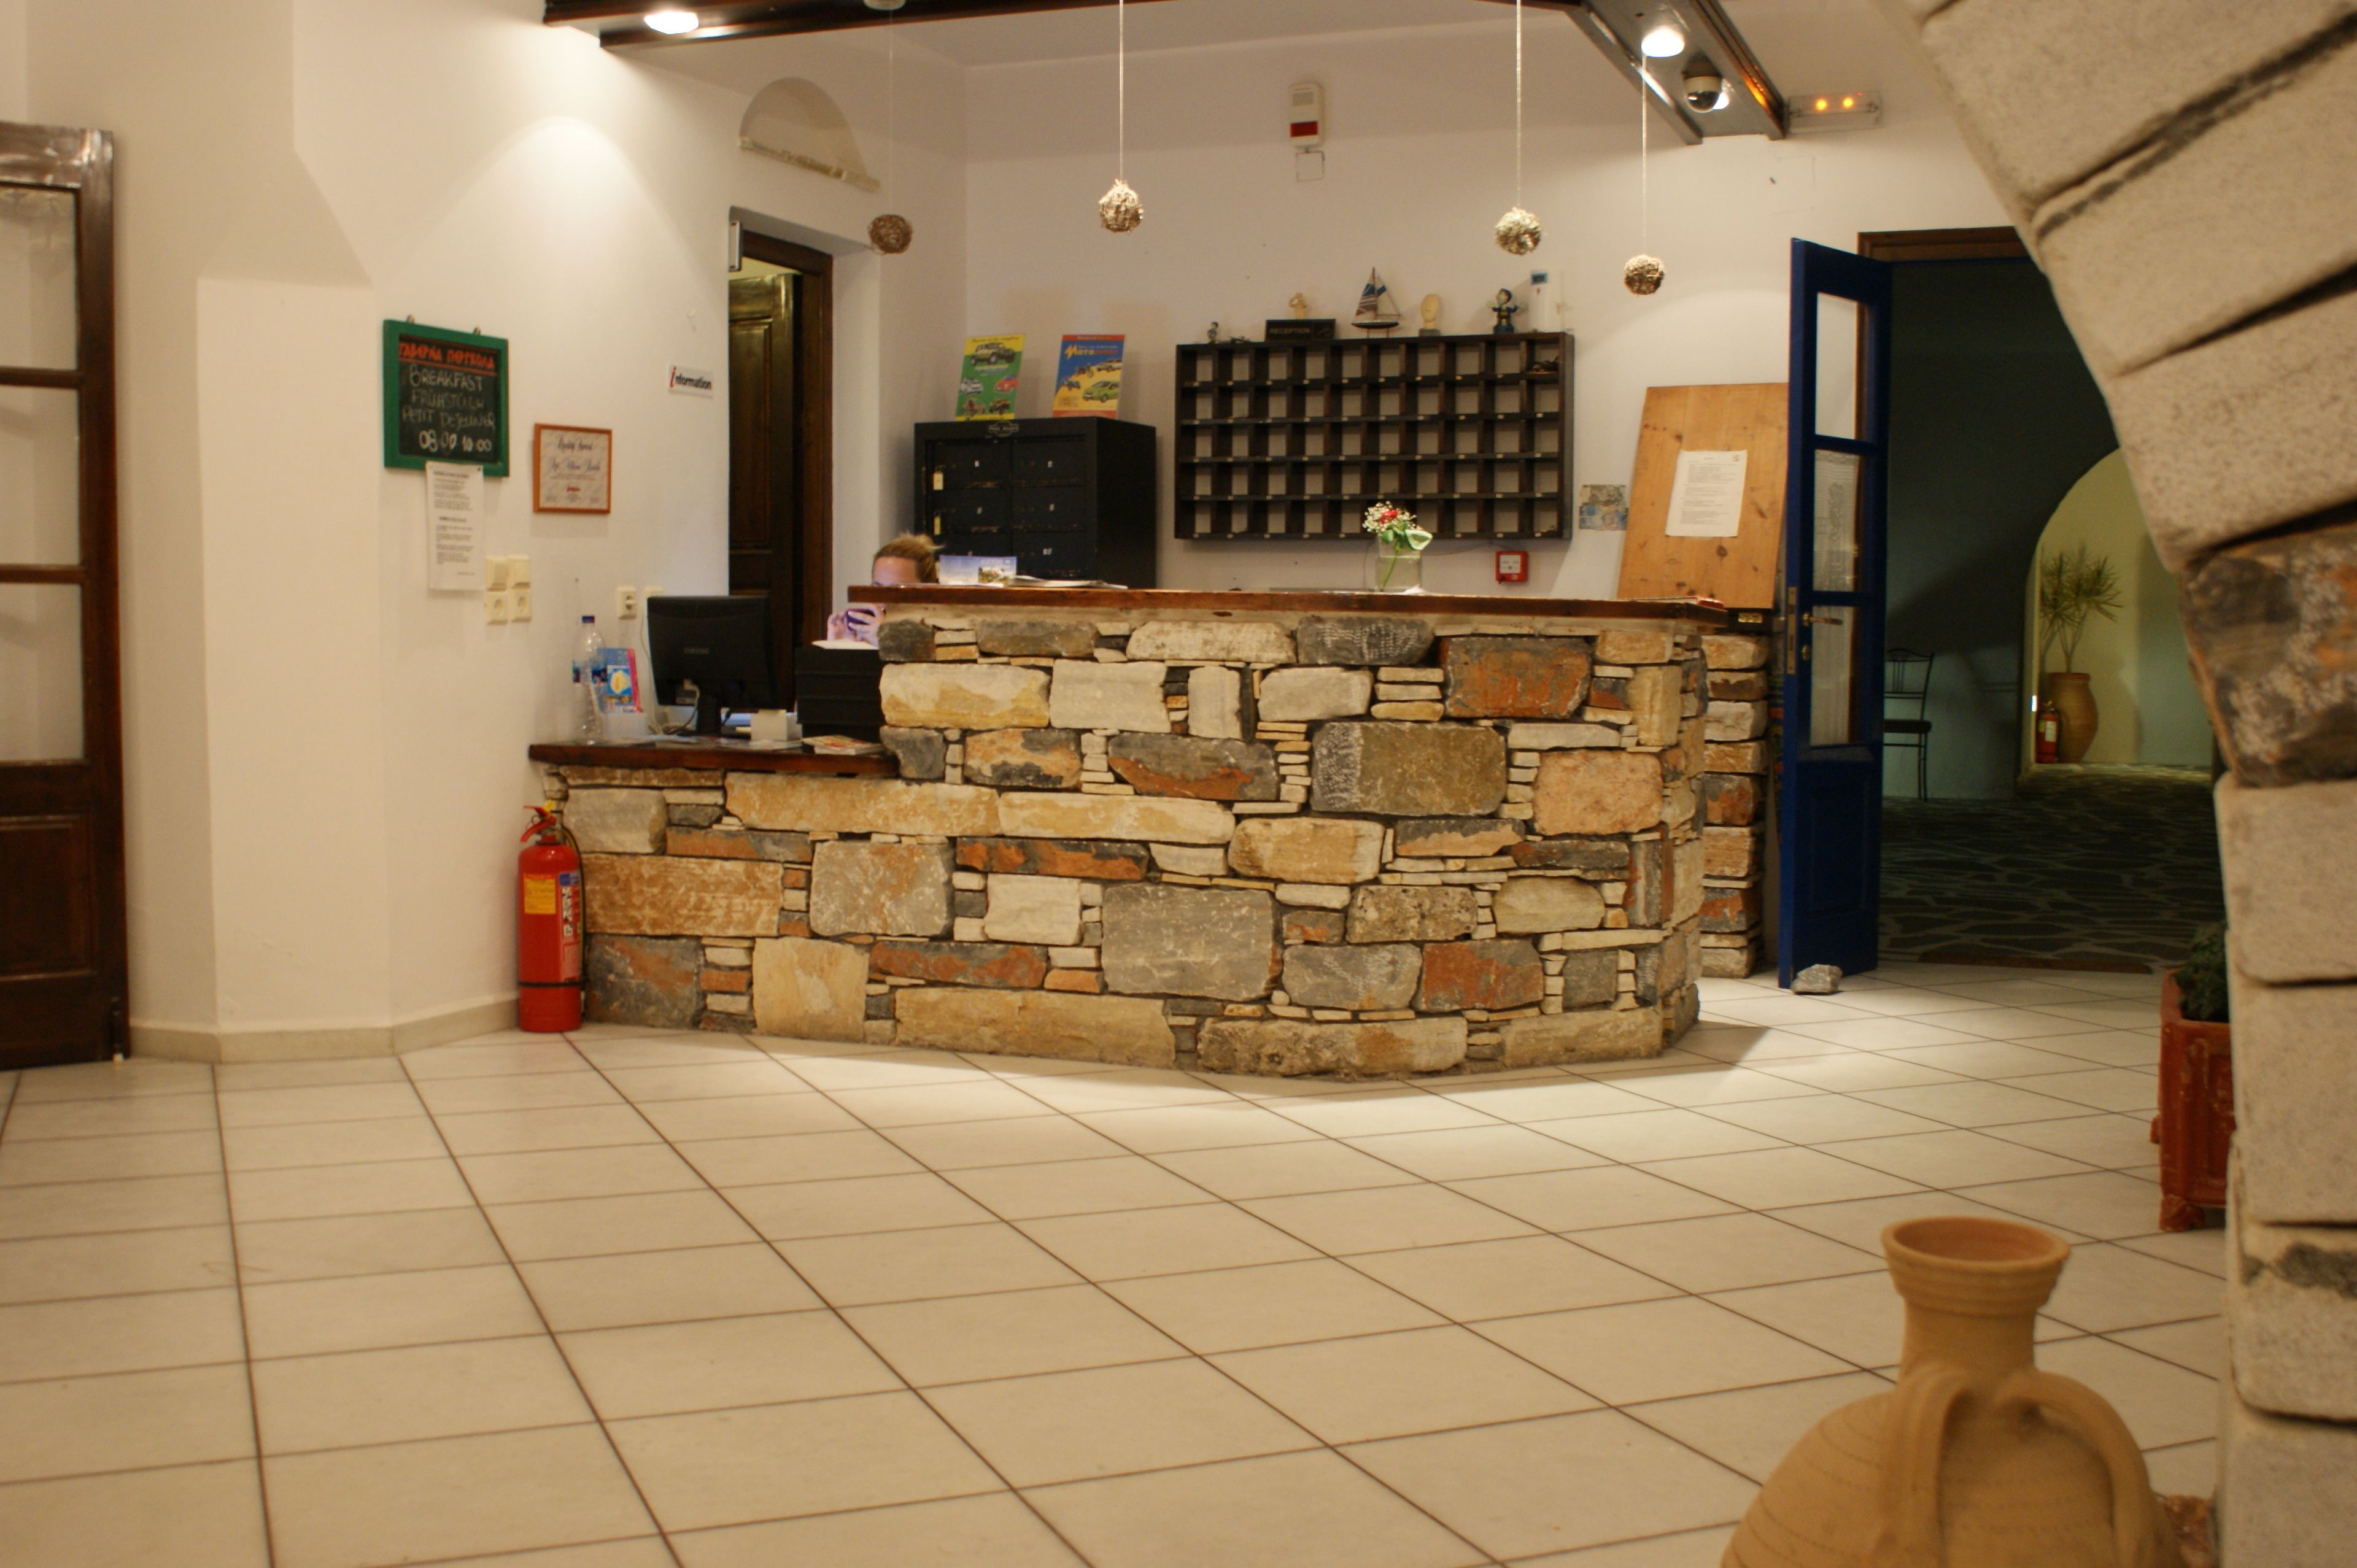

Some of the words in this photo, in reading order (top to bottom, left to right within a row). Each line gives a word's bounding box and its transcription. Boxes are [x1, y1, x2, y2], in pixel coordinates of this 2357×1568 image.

[410, 363, 482, 392] BREAKFAST
[670, 366, 711, 390] information
[402, 405, 435, 423] PETIT
